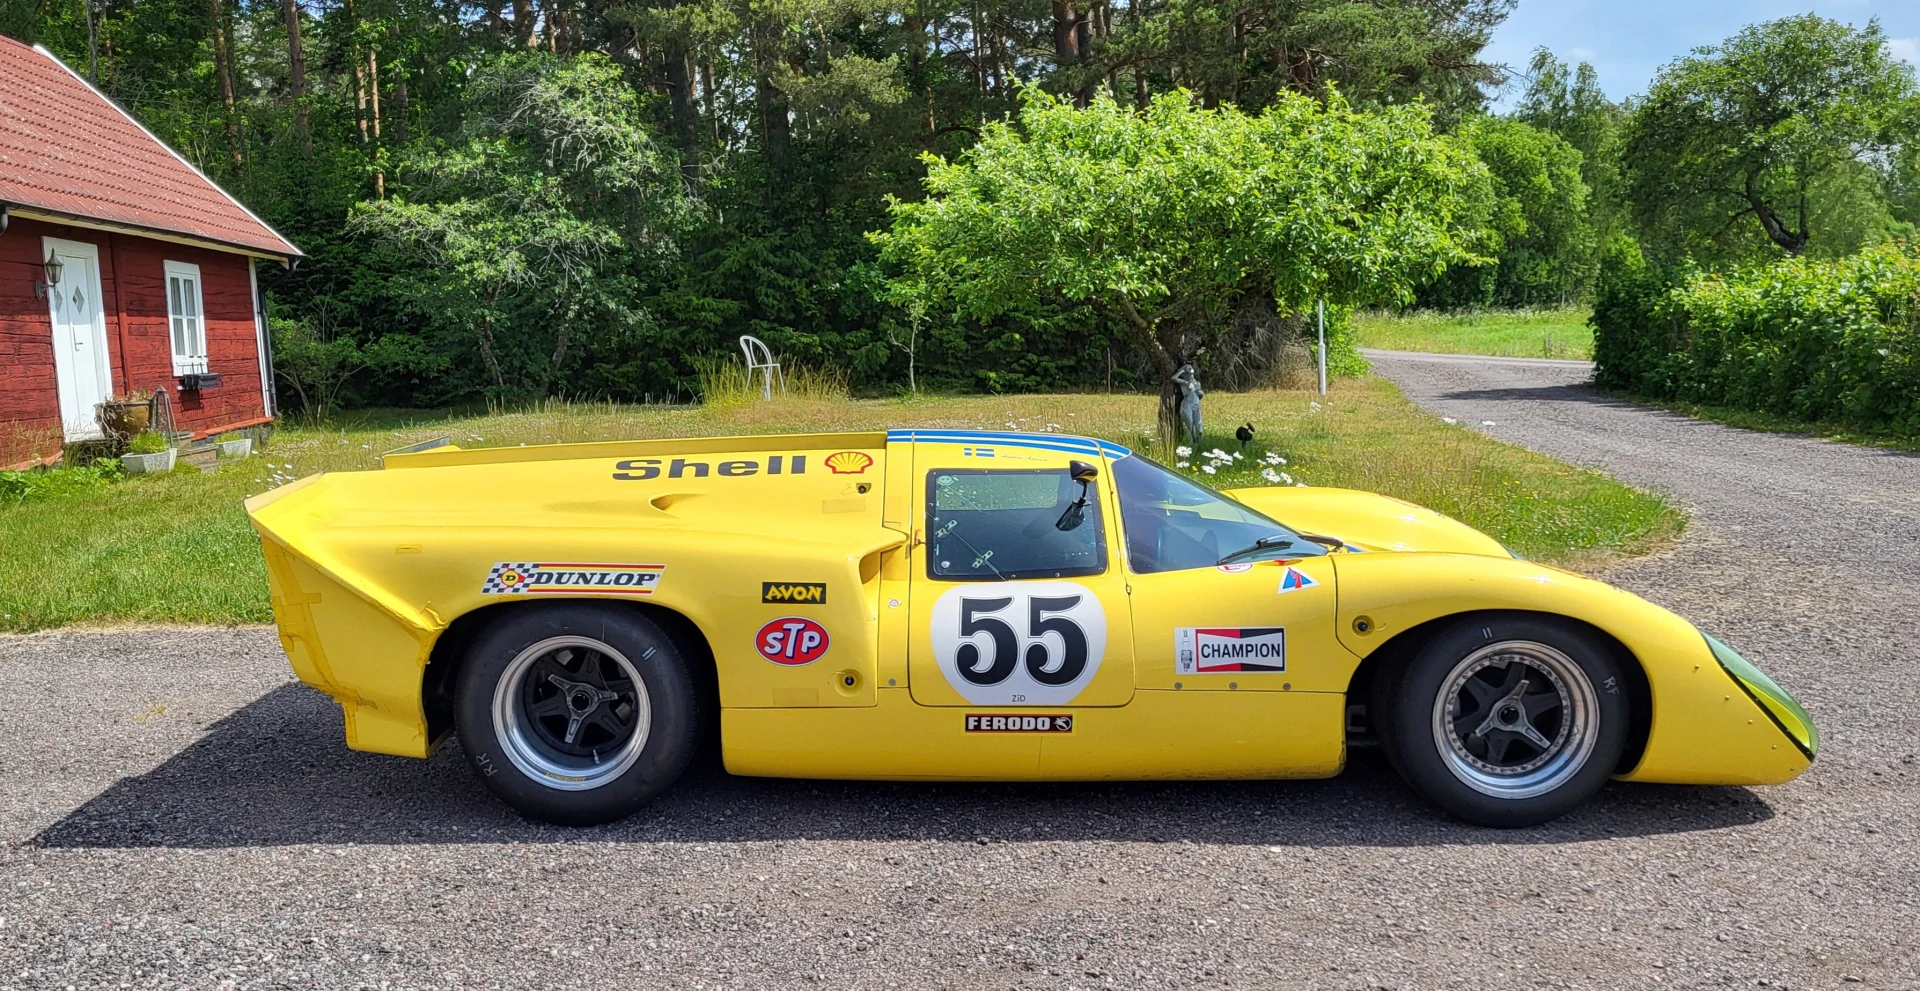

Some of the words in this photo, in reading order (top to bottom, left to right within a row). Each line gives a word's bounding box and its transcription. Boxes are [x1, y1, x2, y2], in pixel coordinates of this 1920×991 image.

[612, 455, 806, 481] Shell
[532, 572, 657, 586] DUNLOP
[765, 584, 823, 601] AVON
[764, 623, 821, 660] STP
[953, 593, 1089, 687] 55
[1201, 643, 1281, 659] CHAMPION
[1603, 676, 1620, 694] RF
[967, 716, 1051, 731] FERODO
[476, 752, 498, 777] RR
